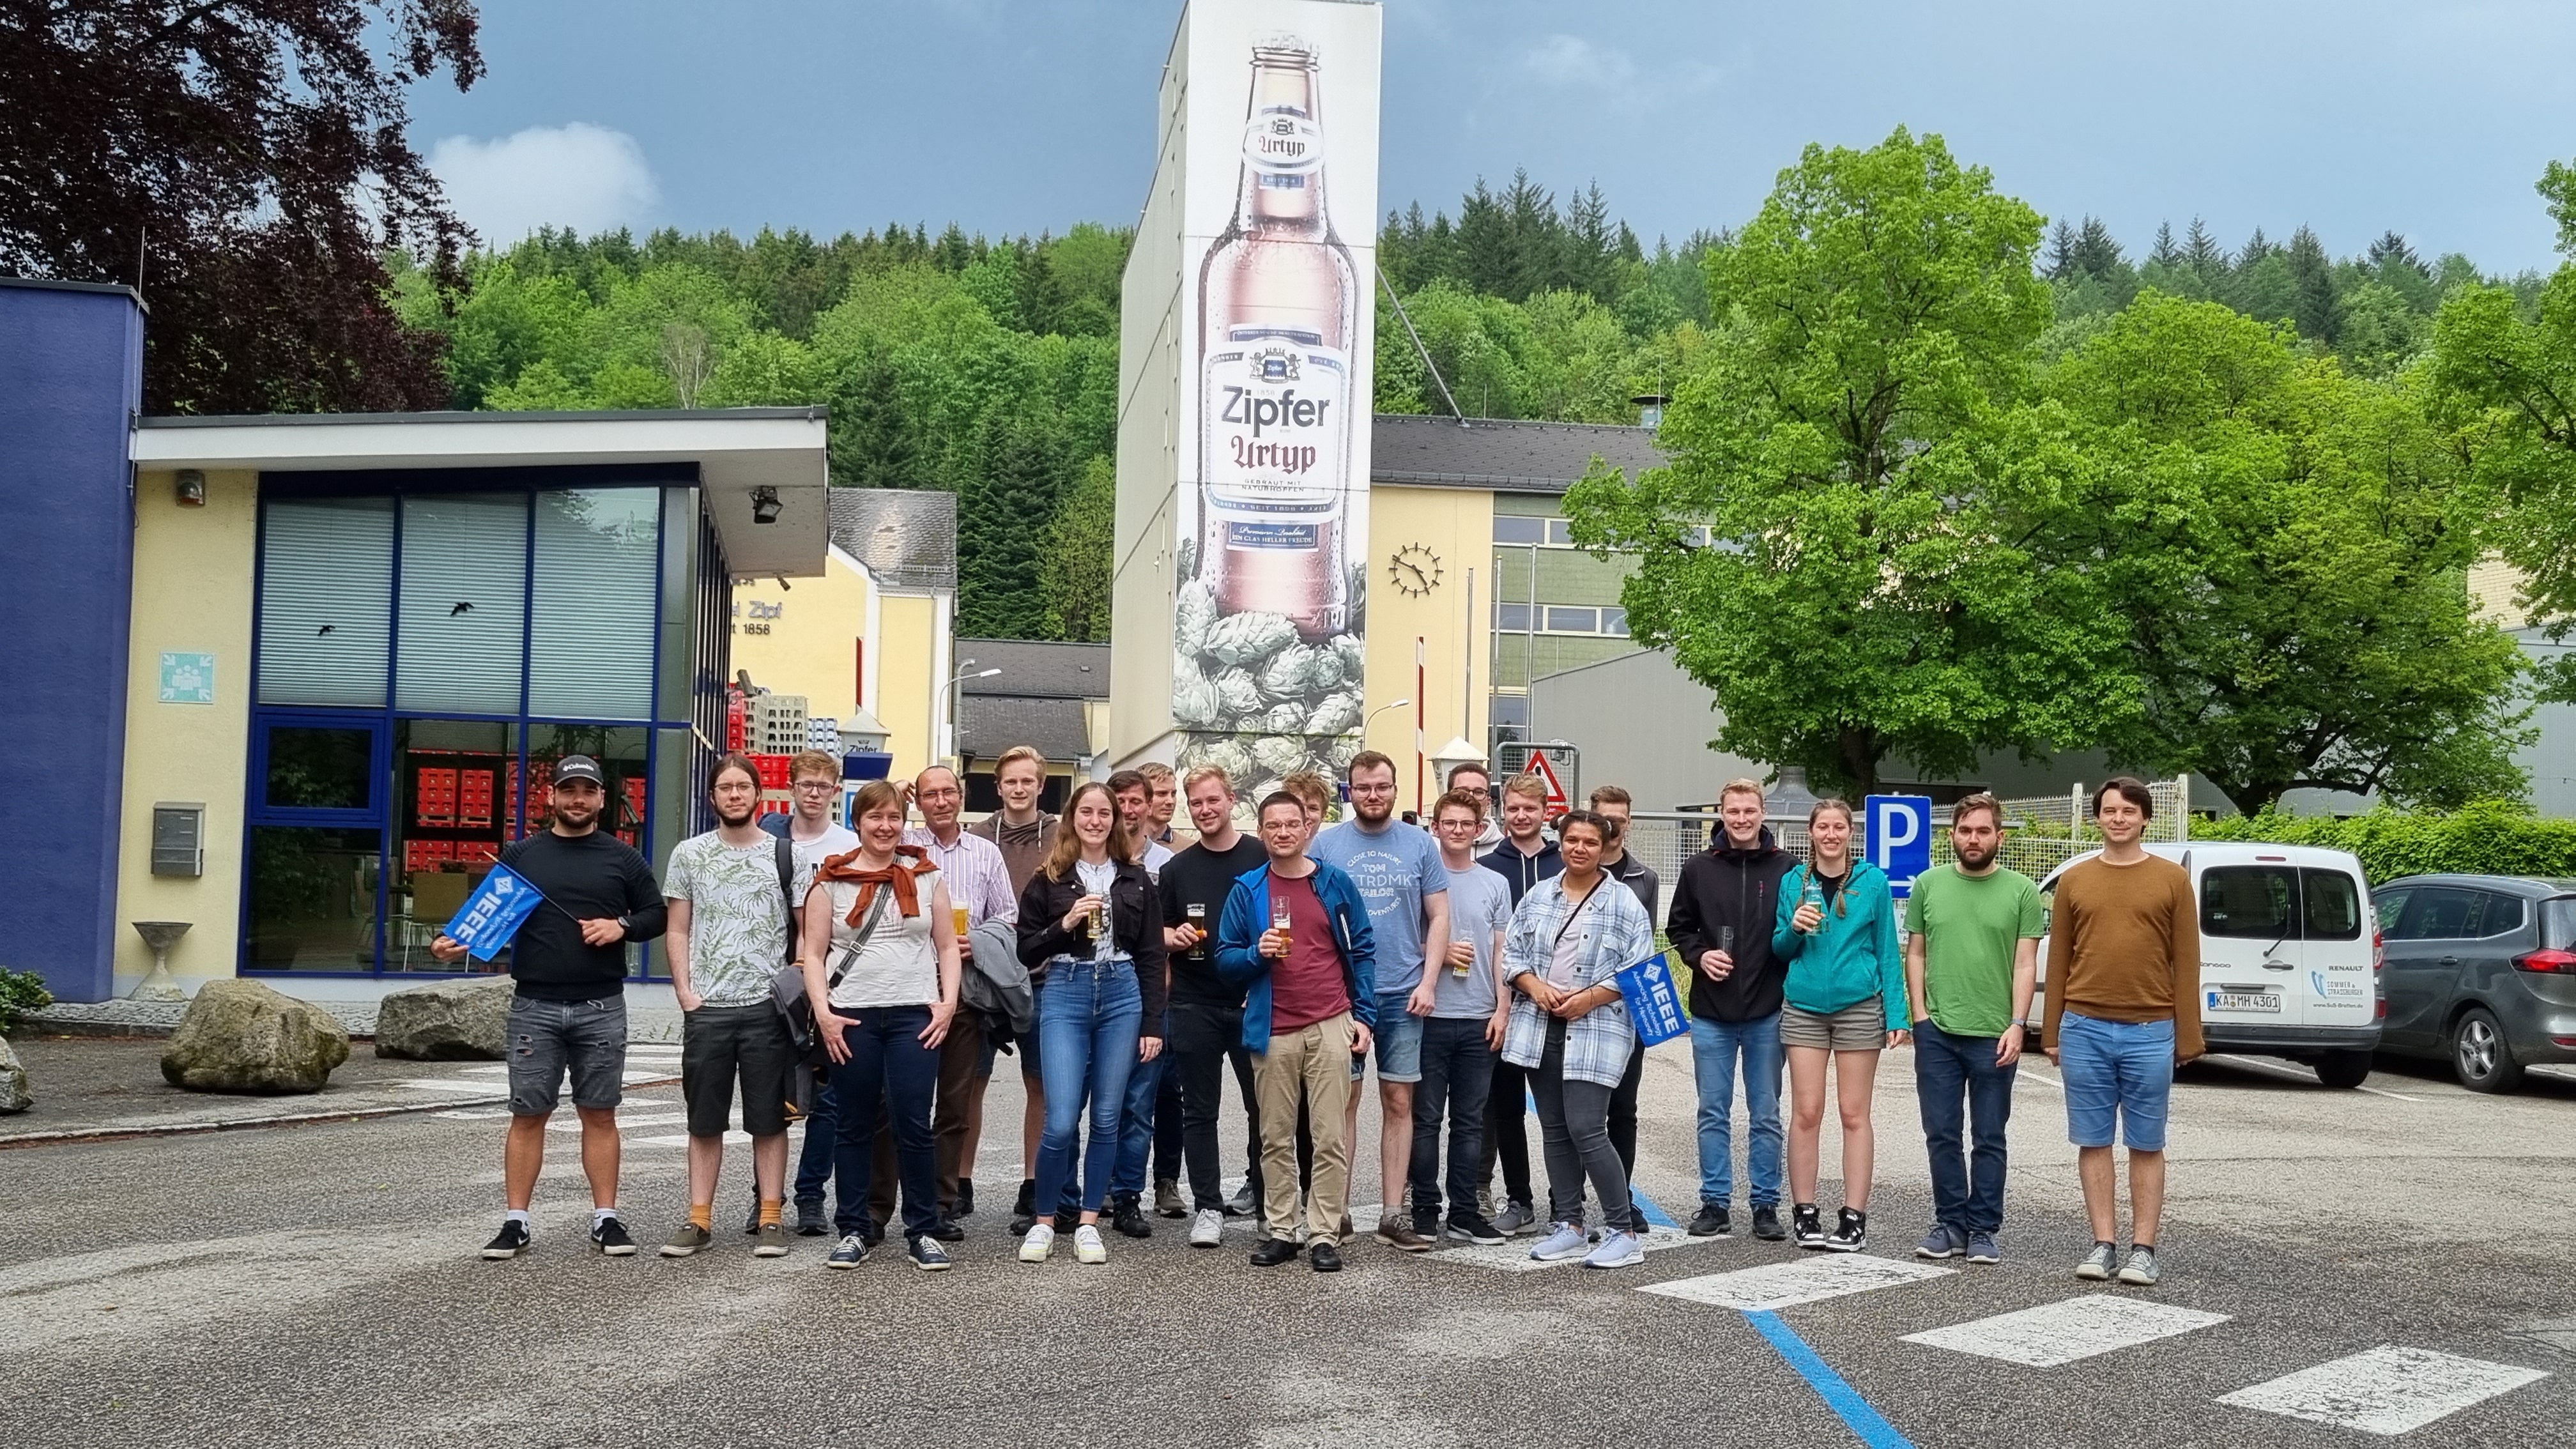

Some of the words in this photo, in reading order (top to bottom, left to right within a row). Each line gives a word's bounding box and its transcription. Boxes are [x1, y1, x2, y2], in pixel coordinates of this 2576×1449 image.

[1259, 135, 1305, 157] Urtyp
[1221, 385, 1330, 438] Zipfer
[1230, 435, 1316, 475] Urtyp
[749, 601, 782, 621] Zipf
[743, 623, 770, 634] 1858
[1879, 804, 1919, 869] P
[1347, 852, 1366, 867] CLOSE
[1378, 851, 1402, 866] NATURE
[1361, 864, 1386, 873] TOM
[1358, 887, 1394, 897] TAILOR
[454, 892, 502, 942] IEEE
[1632, 971, 1648, 1002] Advancing
[1650, 981, 1680, 1034] IEEE
[2216, 995, 2229, 1006] KA
[2237, 995, 2251, 1007] MH
[2253, 996, 2278, 1008] 4301
